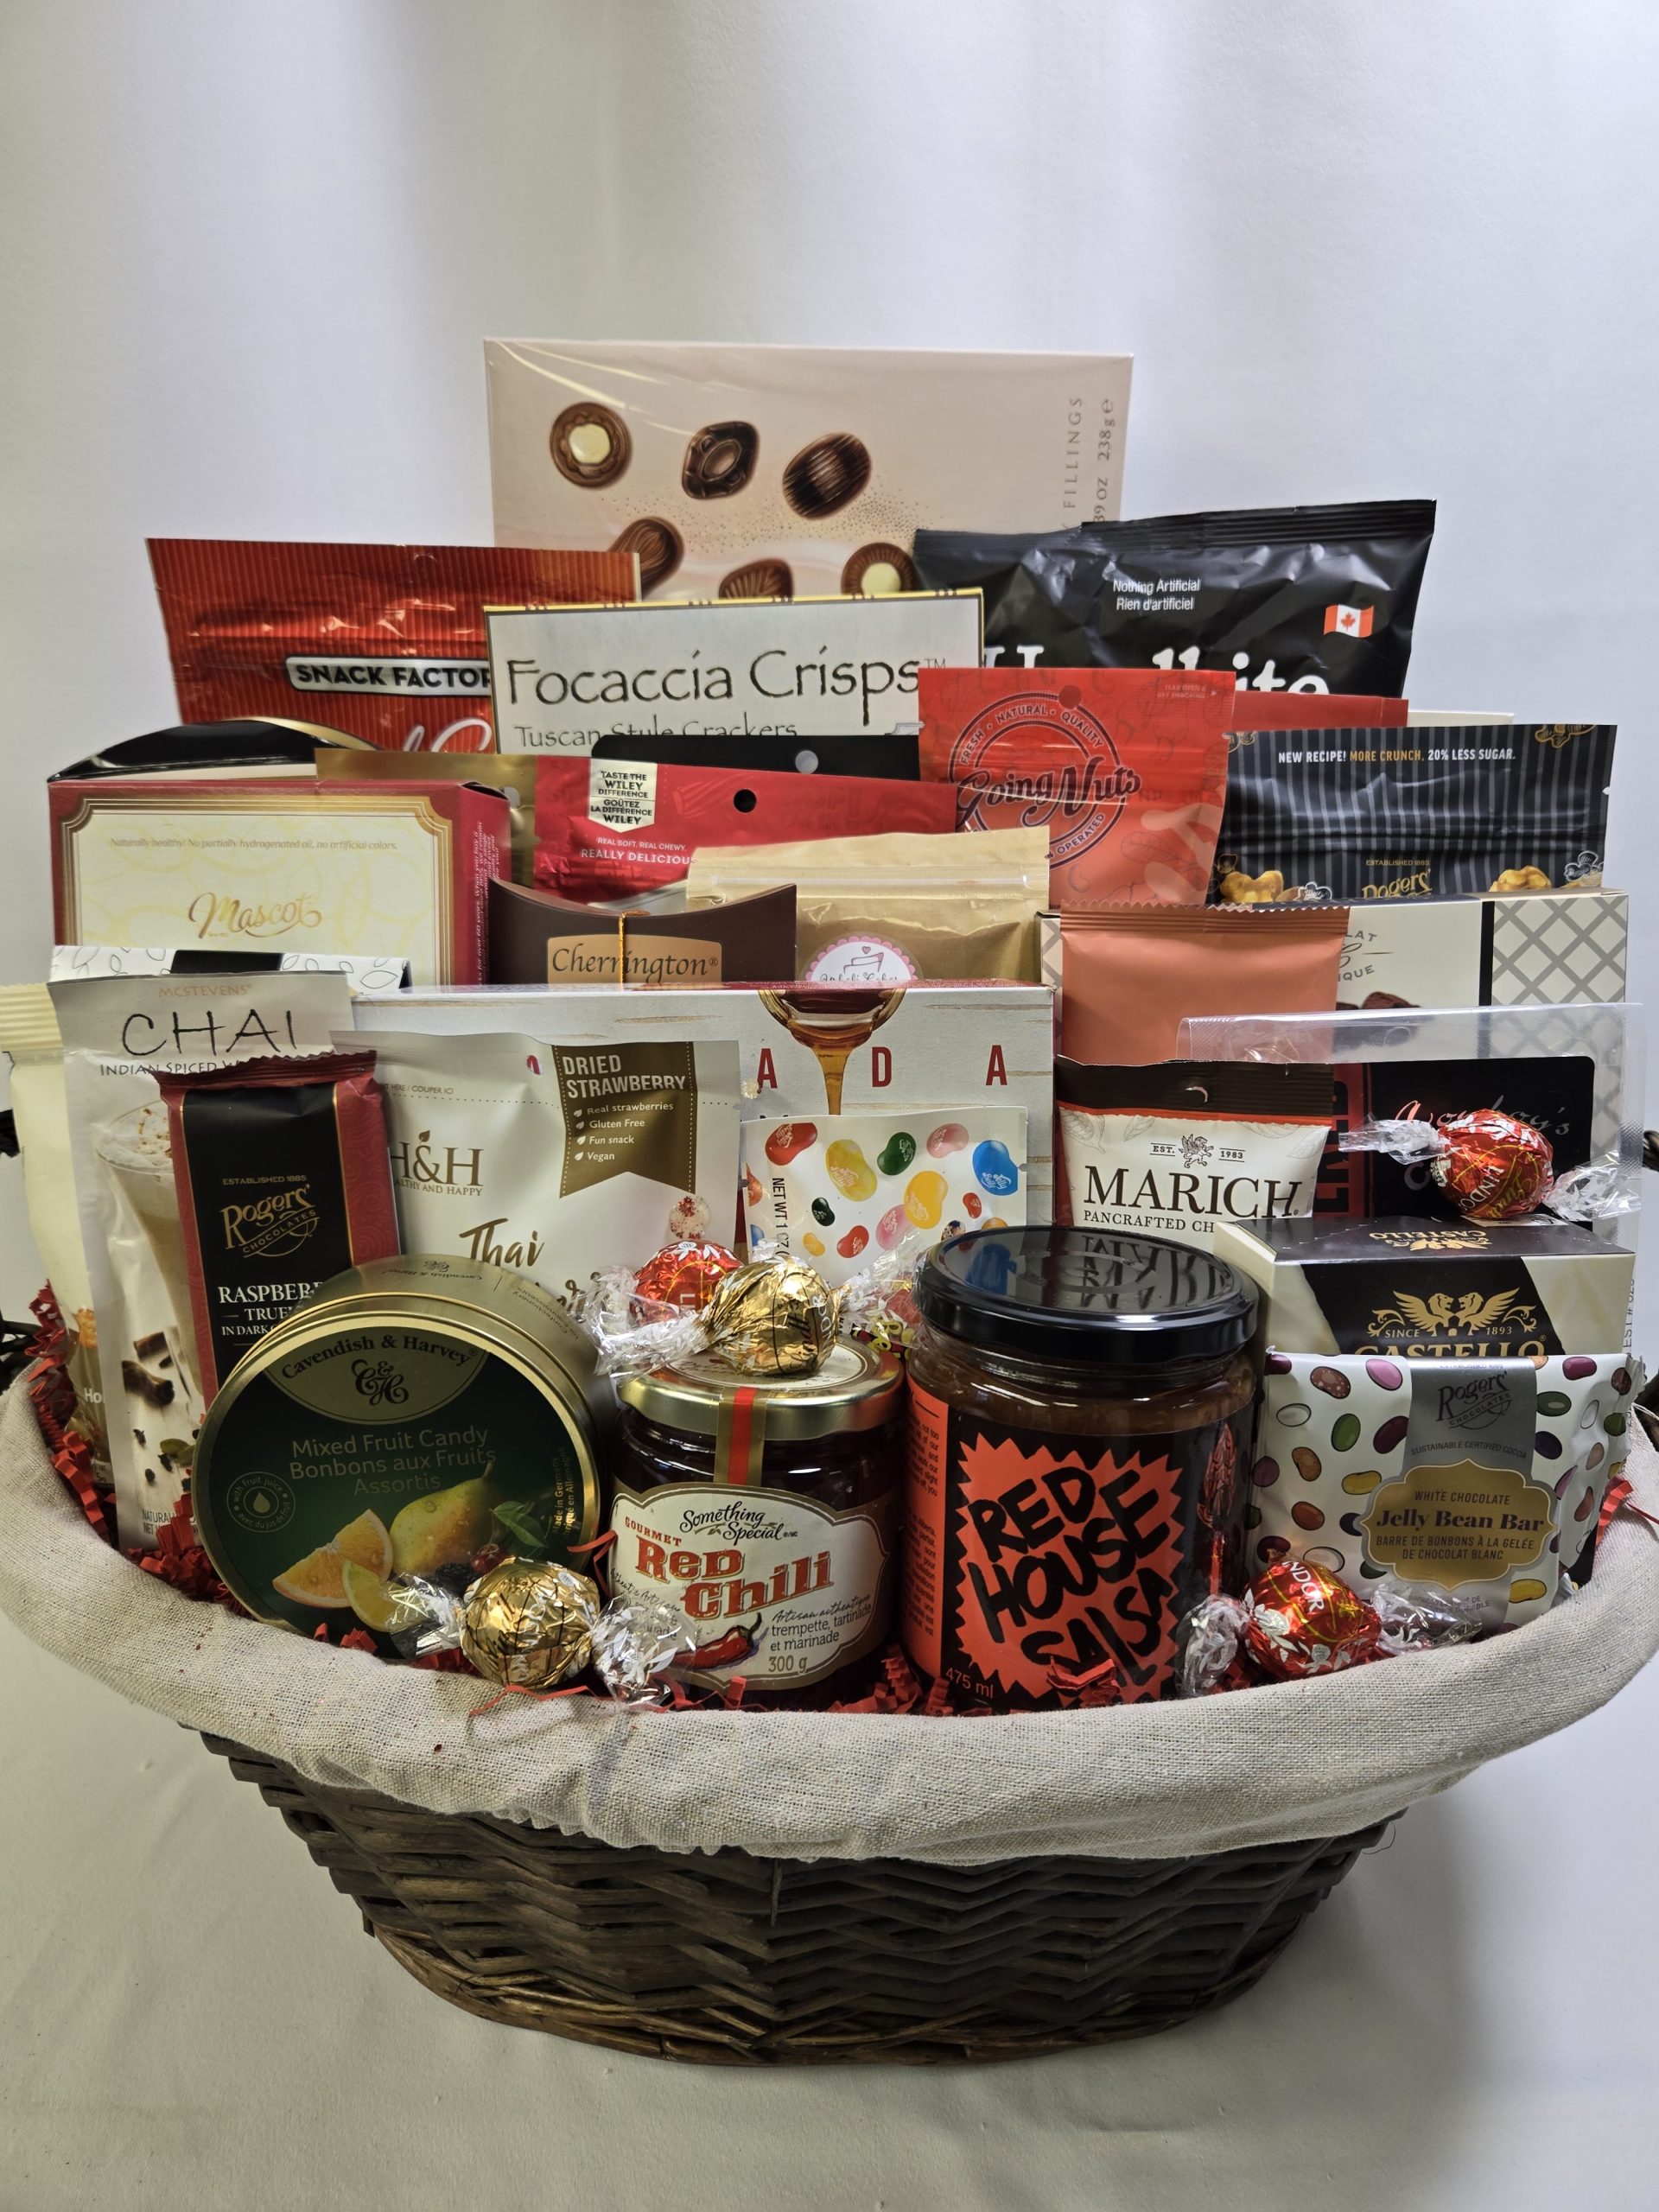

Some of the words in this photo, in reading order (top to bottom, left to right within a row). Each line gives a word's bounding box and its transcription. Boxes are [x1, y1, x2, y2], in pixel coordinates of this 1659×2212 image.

[1063, 397, 1082, 508] FILLINGS
[1096, 477, 1108, 500] OZ
[1113, 578, 1153, 594] Nothing
[1156, 577, 1200, 593] Artificial
[1116, 597, 1141, 610] Rien
[1143, 596, 1194, 610] d'artificiel
[296, 664, 387, 685] SNACK
[506, 650, 733, 705] Focaccia
[750, 645, 920, 726] Crisps
[514, 726, 600, 747] Tuscan
[961, 730, 986, 766] FRESH
[995, 704, 1048, 724] NATURAL
[1061, 710, 1104, 750] QUALITY
[1279, 751, 1302, 764] NEW
[1306, 750, 1346, 763] RECIPE!
[1350, 749, 1376, 762] MORE
[1427, 748, 1449, 761] 20%
[1452, 748, 1476, 760] LESS
[1478, 747, 1516, 760] SUGAR.
[601, 771, 628, 779] TASTE
[630, 772, 647, 781] THE
[605, 779, 643, 791] WILEY
[599, 789, 648, 798] DIFFERENCE
[957, 766, 1053, 820] Going
[1027, 756, 1141, 826] Nuts
[603, 798, 640, 808] GOÛTEZ
[603, 815, 641, 824] WILEY
[111, 837, 149, 849] Naturally
[188, 839, 200, 848] No
[201, 838, 237, 850] partially
[239, 837, 300, 851] hydrogenated
[330, 840, 366, 851] artificial
[1057, 814, 1104, 854] OPERATED
[581, 849, 625, 860] REALLY
[628, 853, 694, 864] DELICIOU
[188, 892, 322, 939] Mascot
[122, 1008, 297, 1056] CHAI
[100, 1063, 161, 1077] INDIAN
[563, 1053, 621, 1076] DRIED
[411, 1085, 442, 1094] COUPER
[566, 1074, 686, 1099] STRAWBERRY
[587, 1105, 609, 1116] Real
[612, 1102, 674, 1113] strawberries
[589, 1118, 622, 1129] Gluten
[625, 1117, 645, 1128] Free
[588, 1135, 606, 1146] Fun
[607, 1134, 634, 1145] snack
[587, 1151, 615, 1162] Vegan
[1152, 1145, 1175, 1154] EST.
[1220, 1150, 1244, 1160] 1983
[223, 1176, 285, 1185] ESTABLISHED
[286, 1174, 307, 1183] 1885
[772, 1178, 786, 1199] NET
[423, 1184, 443, 1194] AND
[447, 1186, 484, 1197] HAPPY
[1084, 1165, 1302, 1219] MARICH
[219, 1183, 316, 1249] Rogers'
[774, 1202, 788, 1220] WT
[1084, 1210, 1186, 1230] PANCRAFTED
[243, 1209, 317, 1254] CHOCOLATES
[459, 1217, 545, 1268] Thai
[221, 1325, 235, 1336] IN
[237, 1325, 270, 1336] DARK
[1384, 1328, 1421, 1338] SINCE
[1485, 1325, 1513, 1336] 1893
[282, 1333, 376, 1381] Cavendish
[381, 1333, 397, 1349] &
[1435, 1370, 1510, 1421] Rogers'
[1449, 1392, 1511, 1426] CHOCOLATES
[292, 1434, 358, 1459] Mixed
[362, 1431, 415, 1453] Fruit
[419, 1426, 488, 1453] Candy
[1411, 1441, 1463, 1456] SUSTAINABLE
[1465, 1440, 1502, 1452] CERTIFIED
[1503, 1445, 1527, 1459] COCOA
[290, 1456, 388, 1480] Bonbons
[392, 1454, 429, 1471] aux
[435, 1446, 497, 1468] Fruits
[353, 1473, 442, 1497] Assortis
[1414, 1491, 1447, 1503] WHITE
[1450, 1491, 1511, 1505] CHOCOLATE
[680, 1500, 766, 1534] Something
[968, 1466, 1096, 1562] RED
[1376, 1510, 1430, 1532] Jelly
[1434, 1510, 1494, 1529] Bean
[1499, 1512, 1544, 1531] Bar
[625, 1516, 683, 1547] GOURMET
[723, 1522, 784, 1546] Special
[1376, 1535, 1408, 1547] BARRE
[1410, 1535, 1424, 1546] DE
[1427, 1535, 1476, 1548] BONBONS
[1486, 1535, 1500, 1548] LA
[1502, 1535, 1535, 1549] GELÉE
[968, 1469, 1172, 1643] HOUSE
[1402, 1549, 1416, 1560] DE
[1419, 1548, 1469, 1560] CHOCOLAT
[1471, 1548, 1504, 1560] BLANC
[681, 1551, 835, 1622] Chili
[771, 1620, 832, 1637] trempette,
[833, 1602, 873, 1628] tartinade
[772, 1608, 817, 1624] Artisan
[1020, 1567, 1173, 1688] SALSA
[770, 1639, 781, 1651] et
[784, 1630, 840, 1651] marinade
[768, 1656, 796, 1673] 300
[798, 1656, 808, 1674] g
[945, 1668, 971, 1690] 475
[975, 1681, 995, 1699] ml
